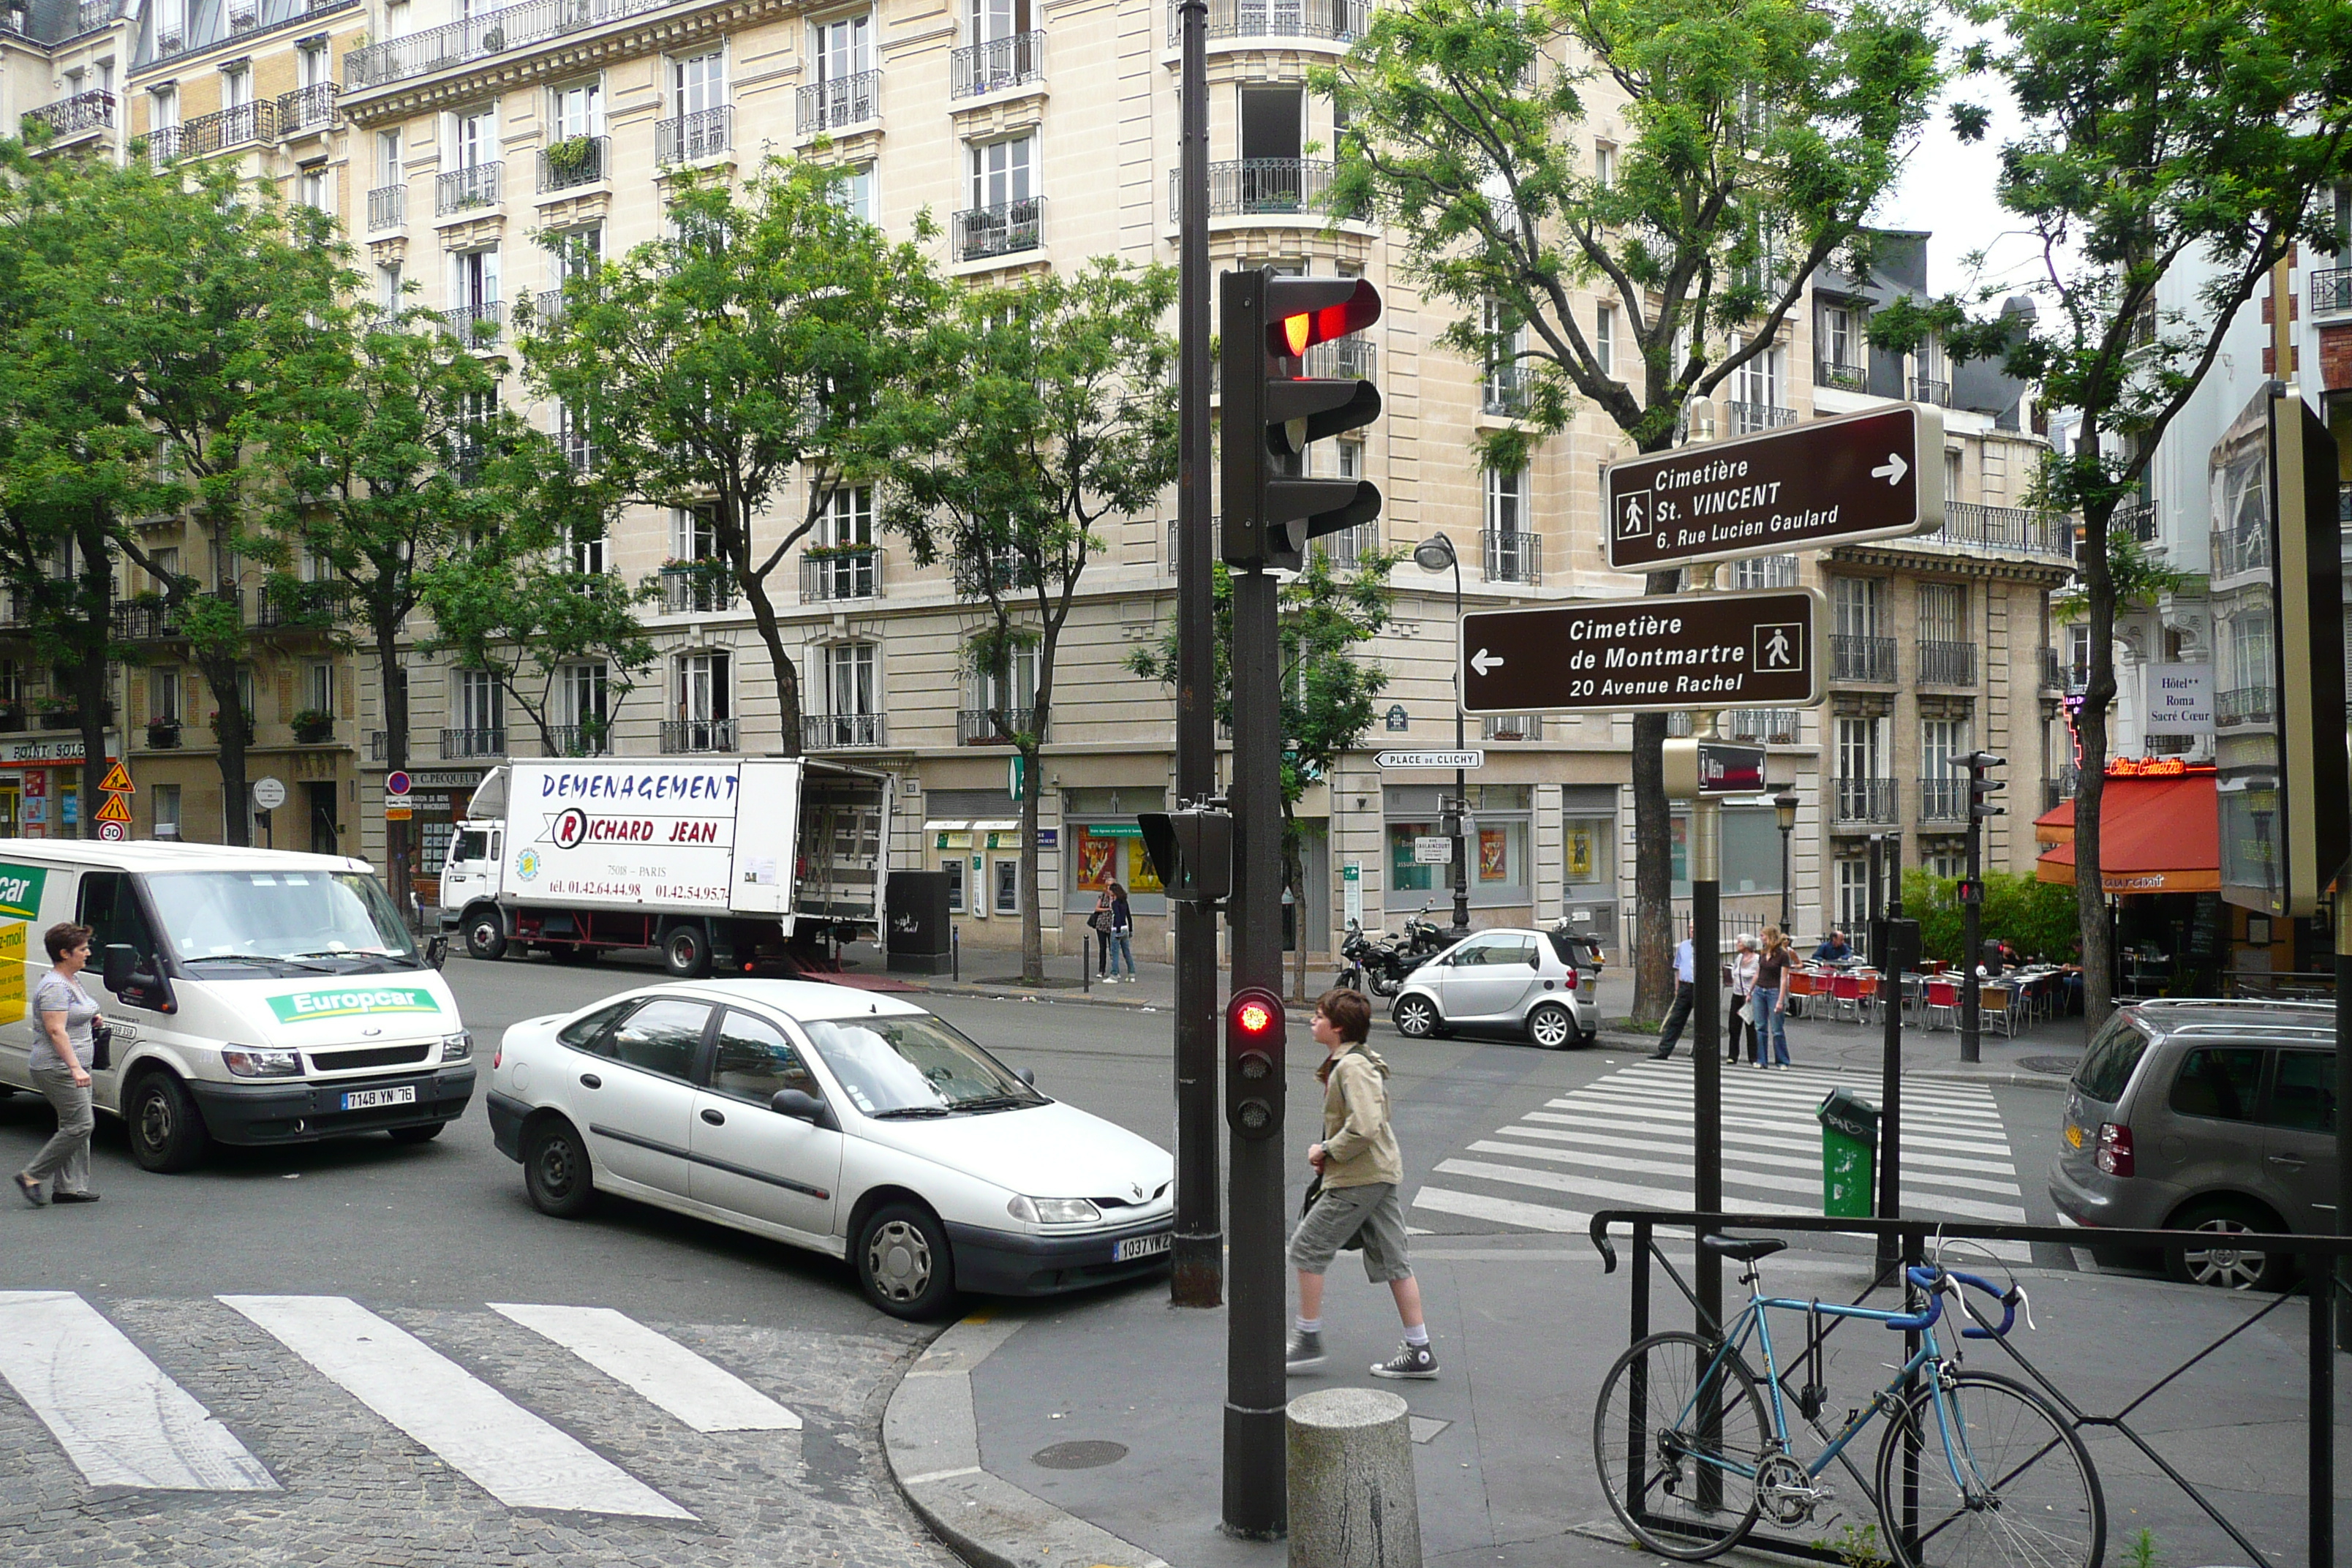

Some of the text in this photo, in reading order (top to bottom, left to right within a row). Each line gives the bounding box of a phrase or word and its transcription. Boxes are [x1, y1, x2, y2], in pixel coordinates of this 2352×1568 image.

[1655, 459, 1748, 491] Cimetière
[1656, 481, 1781, 521] St. VINCENT
[1656, 505, 1839, 549] 6, Rue Lucien Gaulard
[1569, 615, 1682, 641] Cimetière
[1570, 644, 1745, 670] de Montmartre
[1570, 673, 1744, 697] 20 Avenue Rachel
[2166, 695, 2195, 706] Roma
[2151, 710, 2209, 722] Sacré Cœur
[13, 743, 86, 758] POINT SOLE
[1390, 755, 1421, 764] PLACE
[1437, 755, 1474, 764] CLICHY
[1708, 758, 1724, 778] Métro
[543, 774, 739, 800] DEMENAGEMENT
[105, 828, 118, 838] 30
[561, 816, 717, 843] RICHARD JEAN
[1401, 840, 1414, 848] Ban
[607, 865, 627, 876] 75018
[638, 866, 666, 878] PARIS
[2104, 873, 2164, 889] aurant
[549, 881, 566, 894] tél.
[568, 880, 641, 897] 01.42.64.44.98
[292, 992, 415, 1013] Europcar
[349, 1088, 412, 1107] 7148 YN 76
[1123, 1238, 1147, 1258] 1037
[1162, 1232, 1171, 1248] 2
